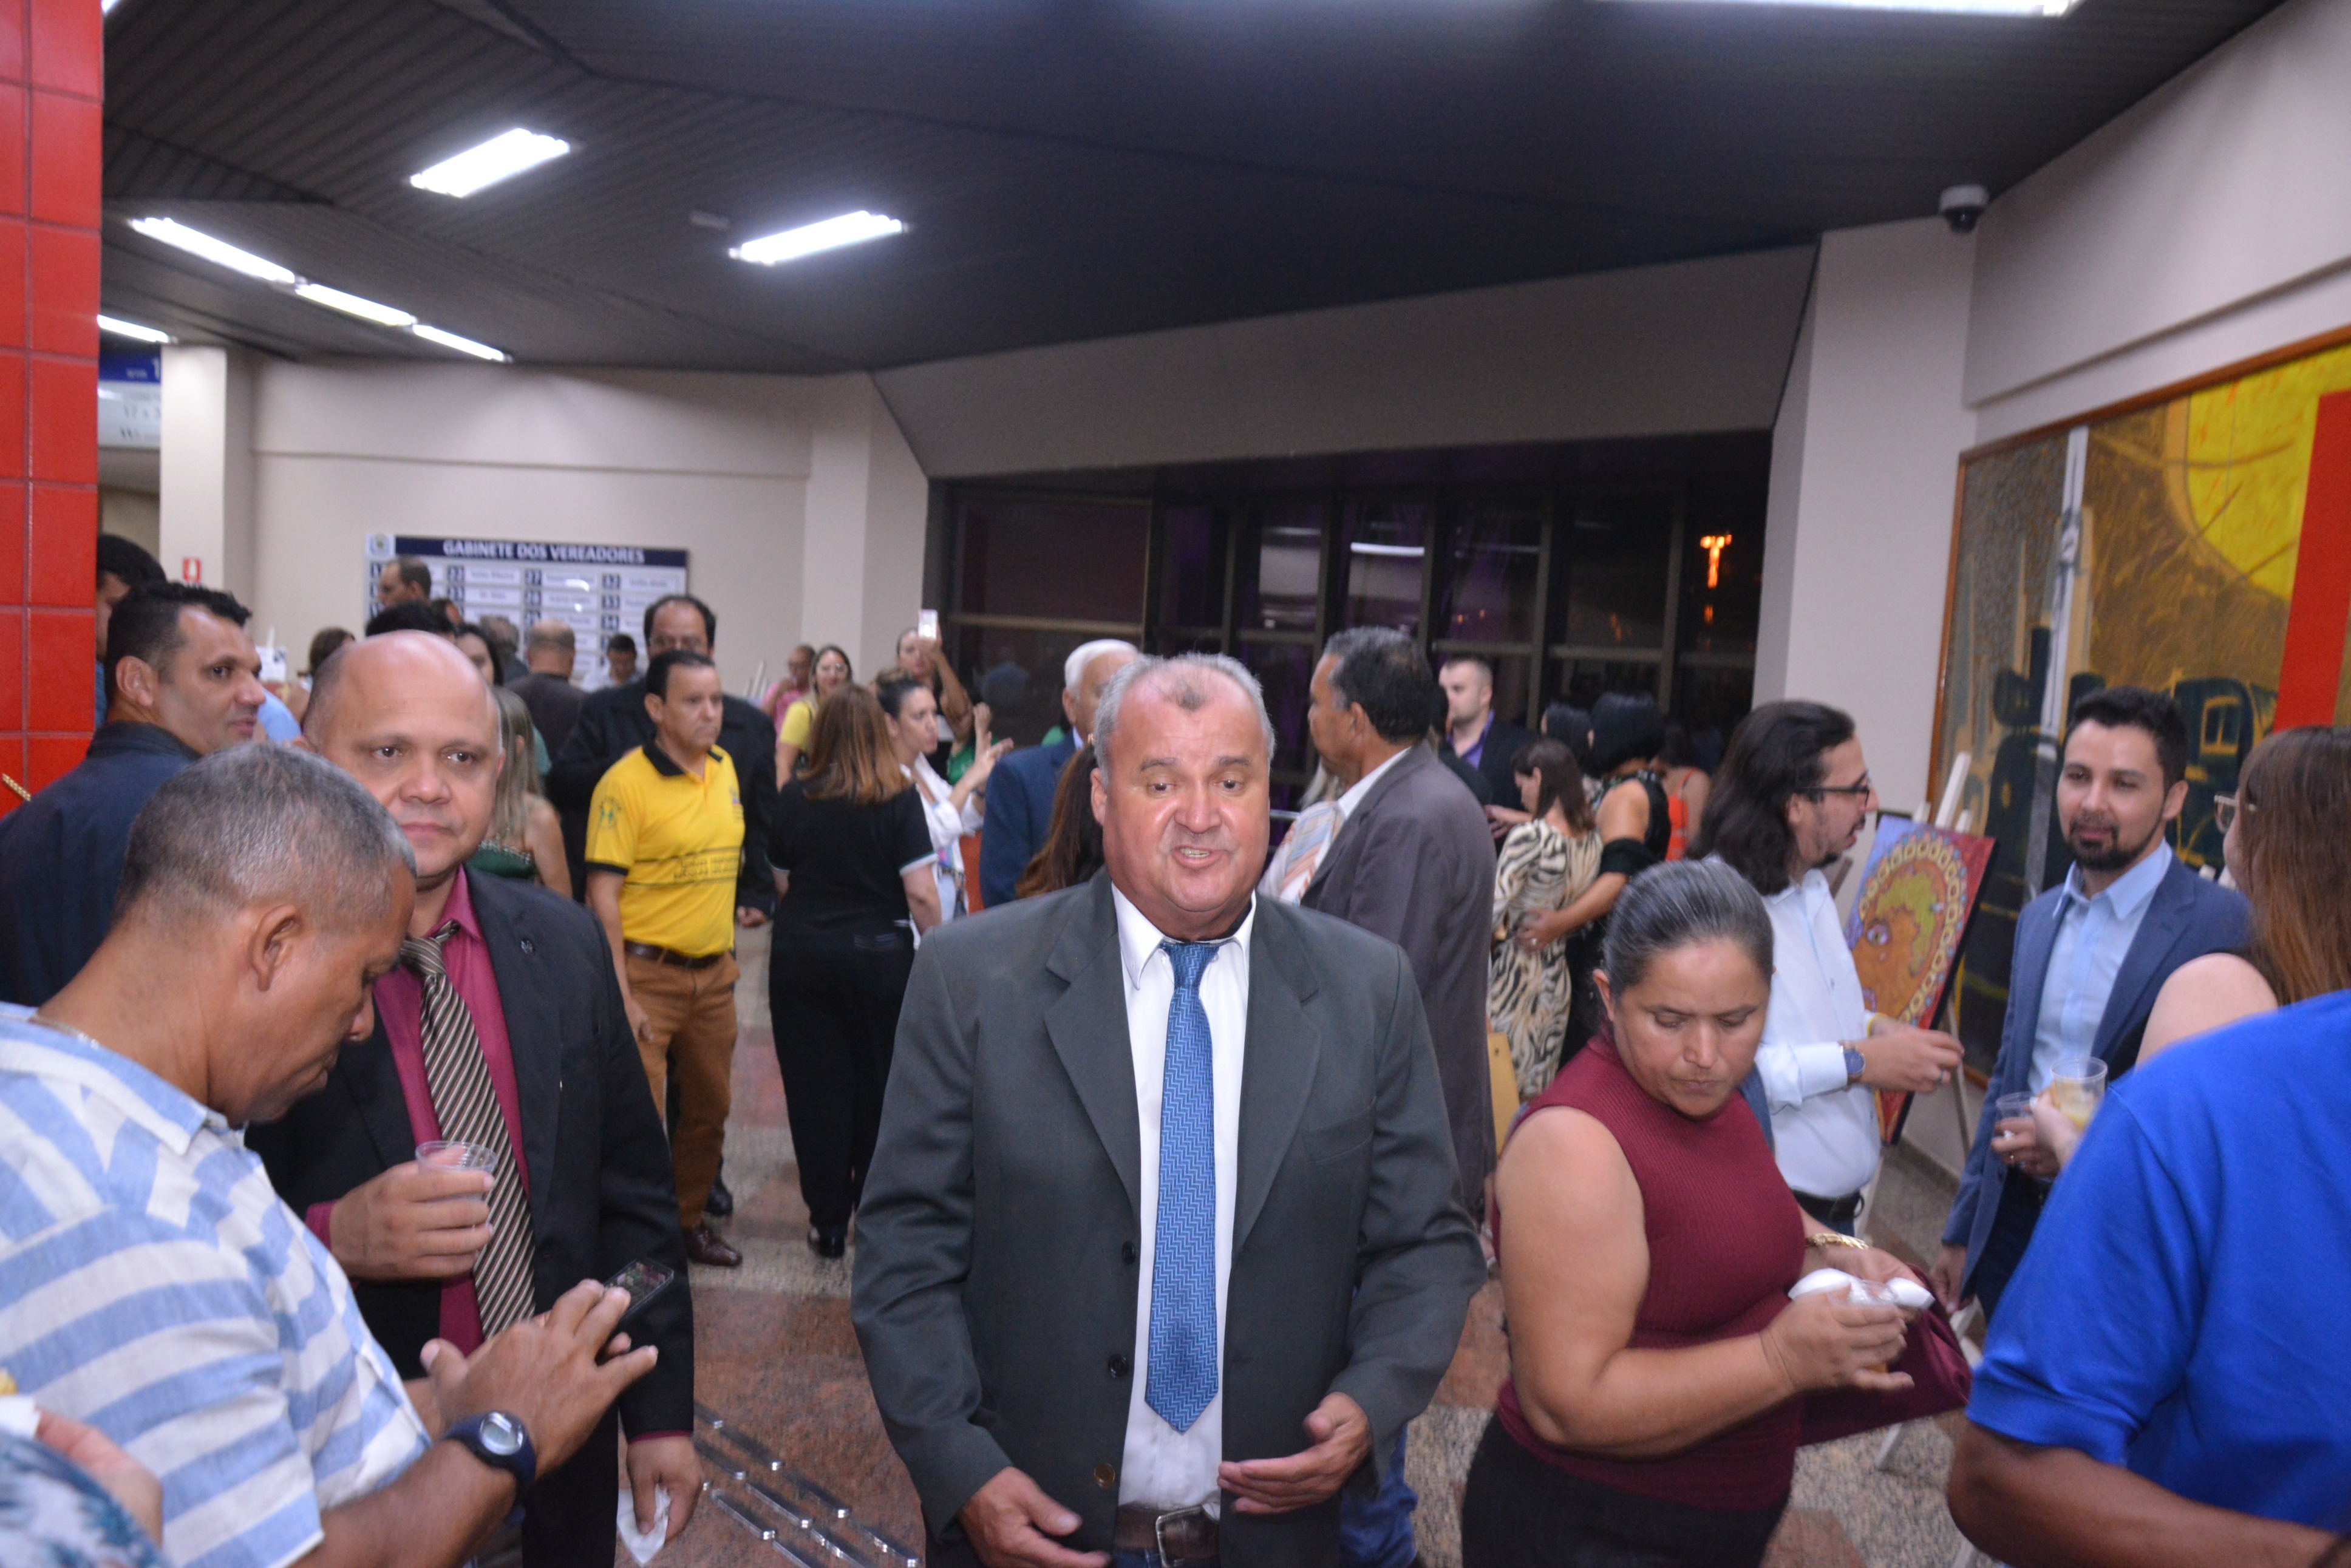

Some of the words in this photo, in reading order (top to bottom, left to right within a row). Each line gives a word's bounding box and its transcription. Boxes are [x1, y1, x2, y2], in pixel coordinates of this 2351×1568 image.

[443, 540, 514, 557] GABINETE
[517, 543, 547, 559] DOS
[549, 545, 645, 563] VEREADORES
